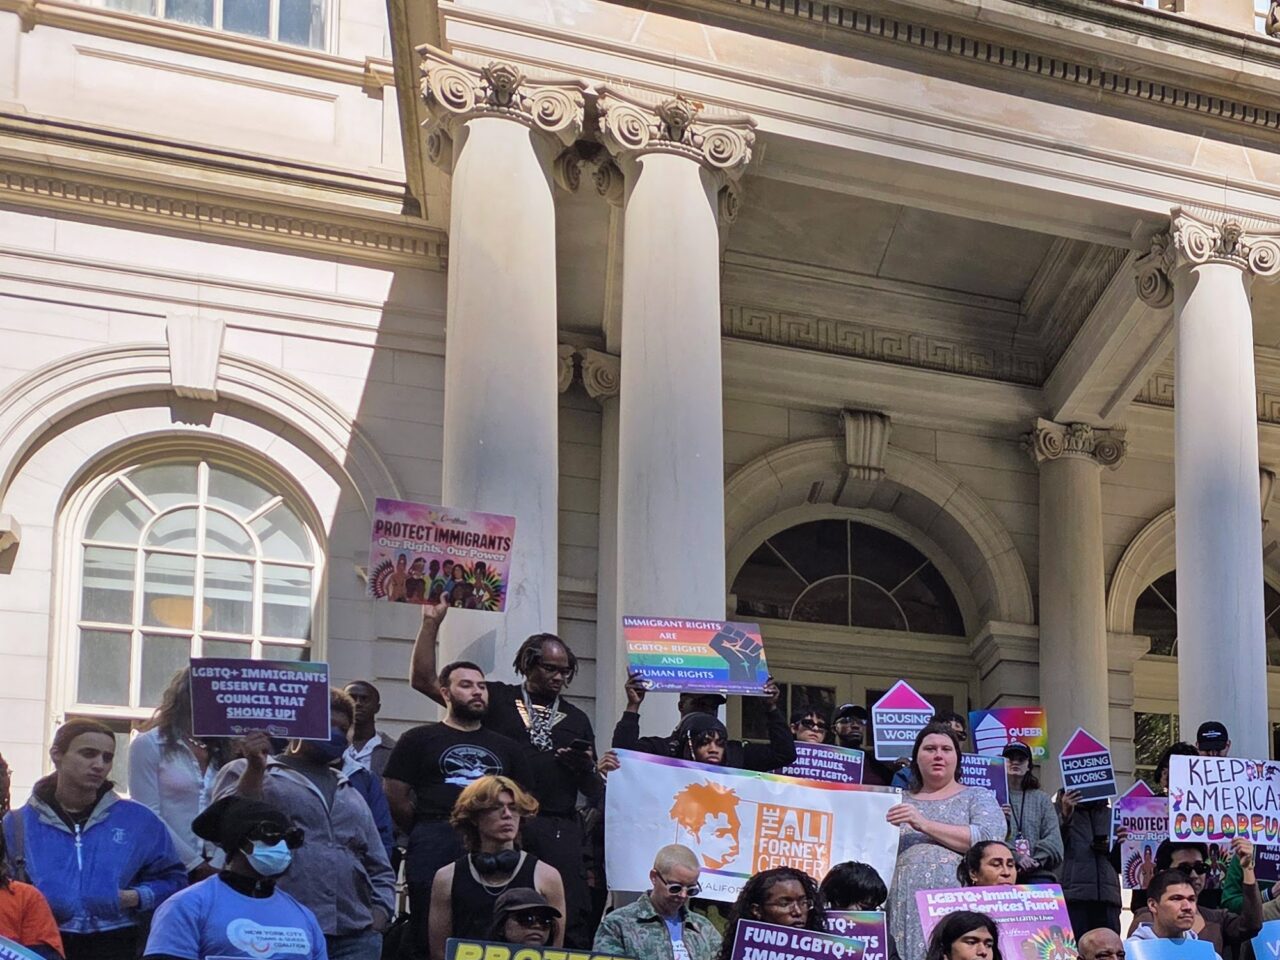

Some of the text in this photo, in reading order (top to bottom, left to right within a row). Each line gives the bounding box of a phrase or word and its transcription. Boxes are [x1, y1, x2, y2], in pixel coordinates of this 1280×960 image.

[375, 519, 433, 541] PROTECT
[434, 527, 512, 552] IMMIGRANTS
[379, 537, 400, 548] Our
[447, 545, 468, 557] Our
[469, 548, 506, 561] Power
[624, 618, 721, 630] IMMIGRANT RIGHTS
[659, 632, 677, 640] ARE
[629, 643, 707, 653] LGBTQ+ RIGHTS
[661, 657, 684, 665] AND
[192, 667, 327, 683] LGBTQ+ IMMIGRANTS
[678, 671, 714, 679] RIGHTS
[211, 681, 309, 694] DESERVE A CITY
[216, 694, 305, 706] COUNCIL THAT
[226, 707, 296, 719] SHOWS UP!
[876, 713, 931, 723] HOUSING
[1009, 727, 1043, 737] QUEER
[812, 749, 861, 764] PRIORITIES
[1063, 756, 1109, 771] HOUSING
[811, 759, 846, 771] VALUES.
[1188, 758, 1245, 786] KEEP
[782, 767, 820, 777] PROTECT
[821, 770, 853, 783] LGBTQ+
[1070, 771, 1107, 784] WORKS
[1185, 784, 1279, 812] AMERICA
[761, 806, 780, 837] THE
[778, 809, 828, 844] ALI
[1123, 817, 1169, 831] PROTECT
[759, 838, 825, 860] FORNEY
[757, 854, 825, 879] CENTER
[927, 888, 1056, 905] LGBTQ+ Immigrant
[970, 900, 1059, 913] Services Fund
[743, 926, 788, 947] FUND
[790, 934, 856, 959] LGBTQ+
